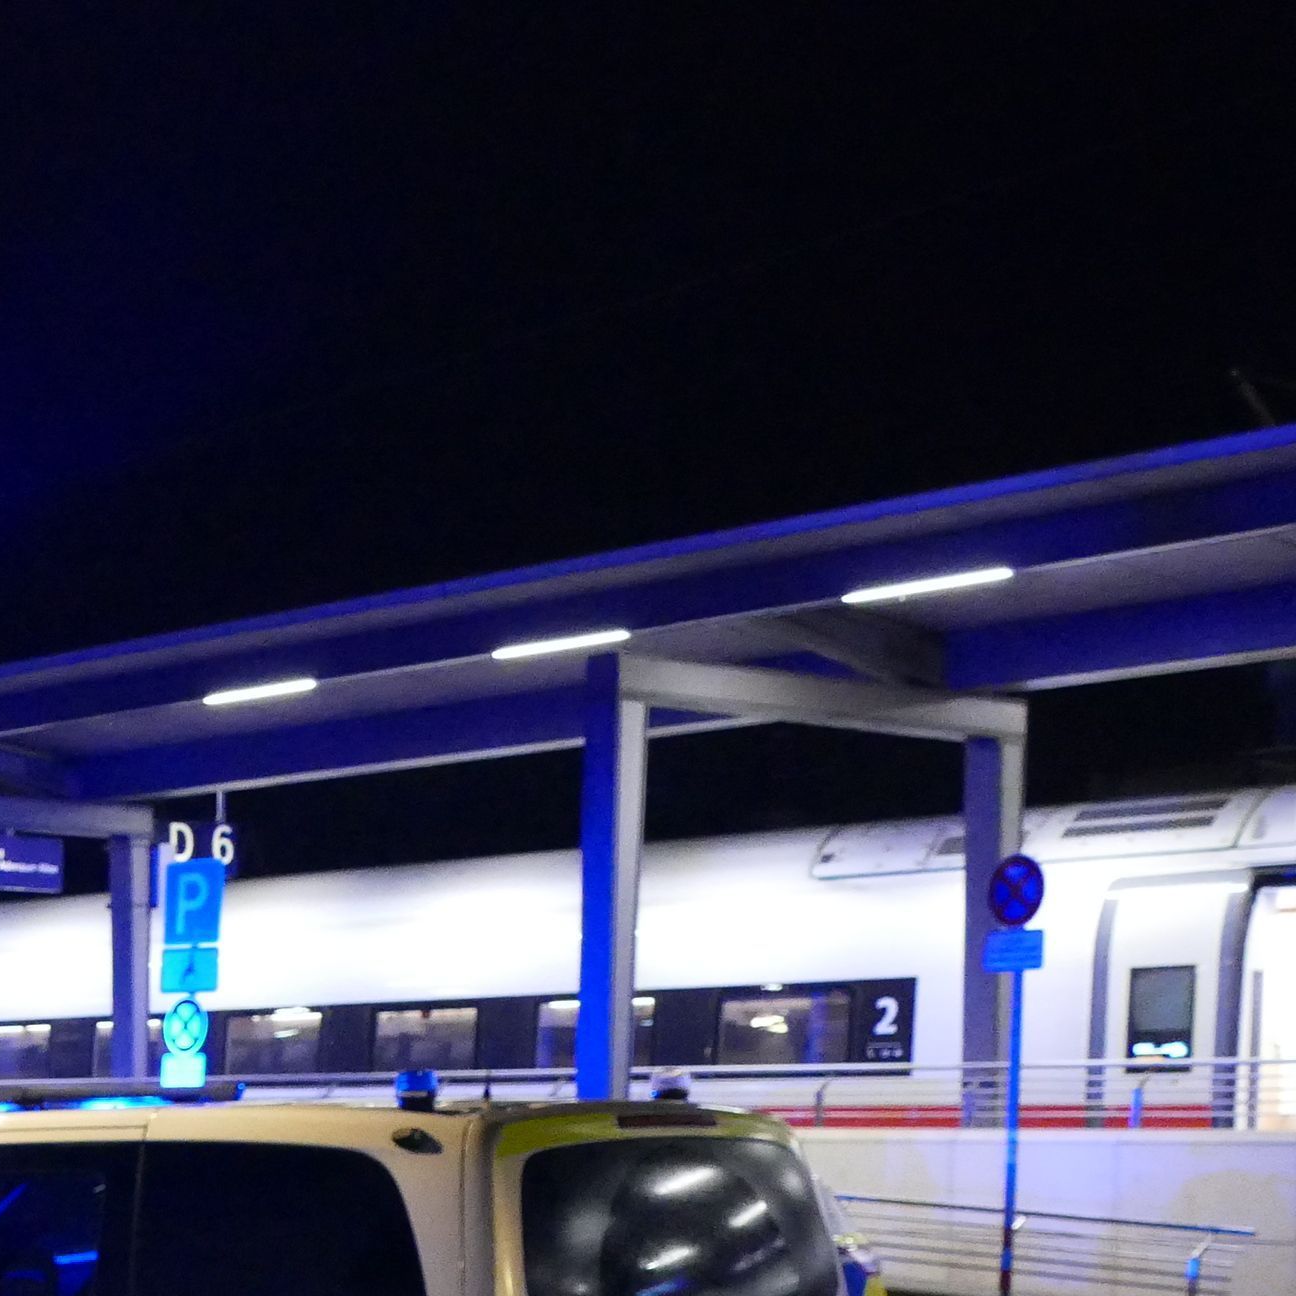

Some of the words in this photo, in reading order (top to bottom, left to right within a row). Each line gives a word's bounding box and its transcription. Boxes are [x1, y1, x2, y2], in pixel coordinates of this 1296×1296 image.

[169, 822, 194, 863] D
[212, 825, 235, 866] 6
[175, 873, 207, 935] P
[873, 996, 899, 1035] 2
